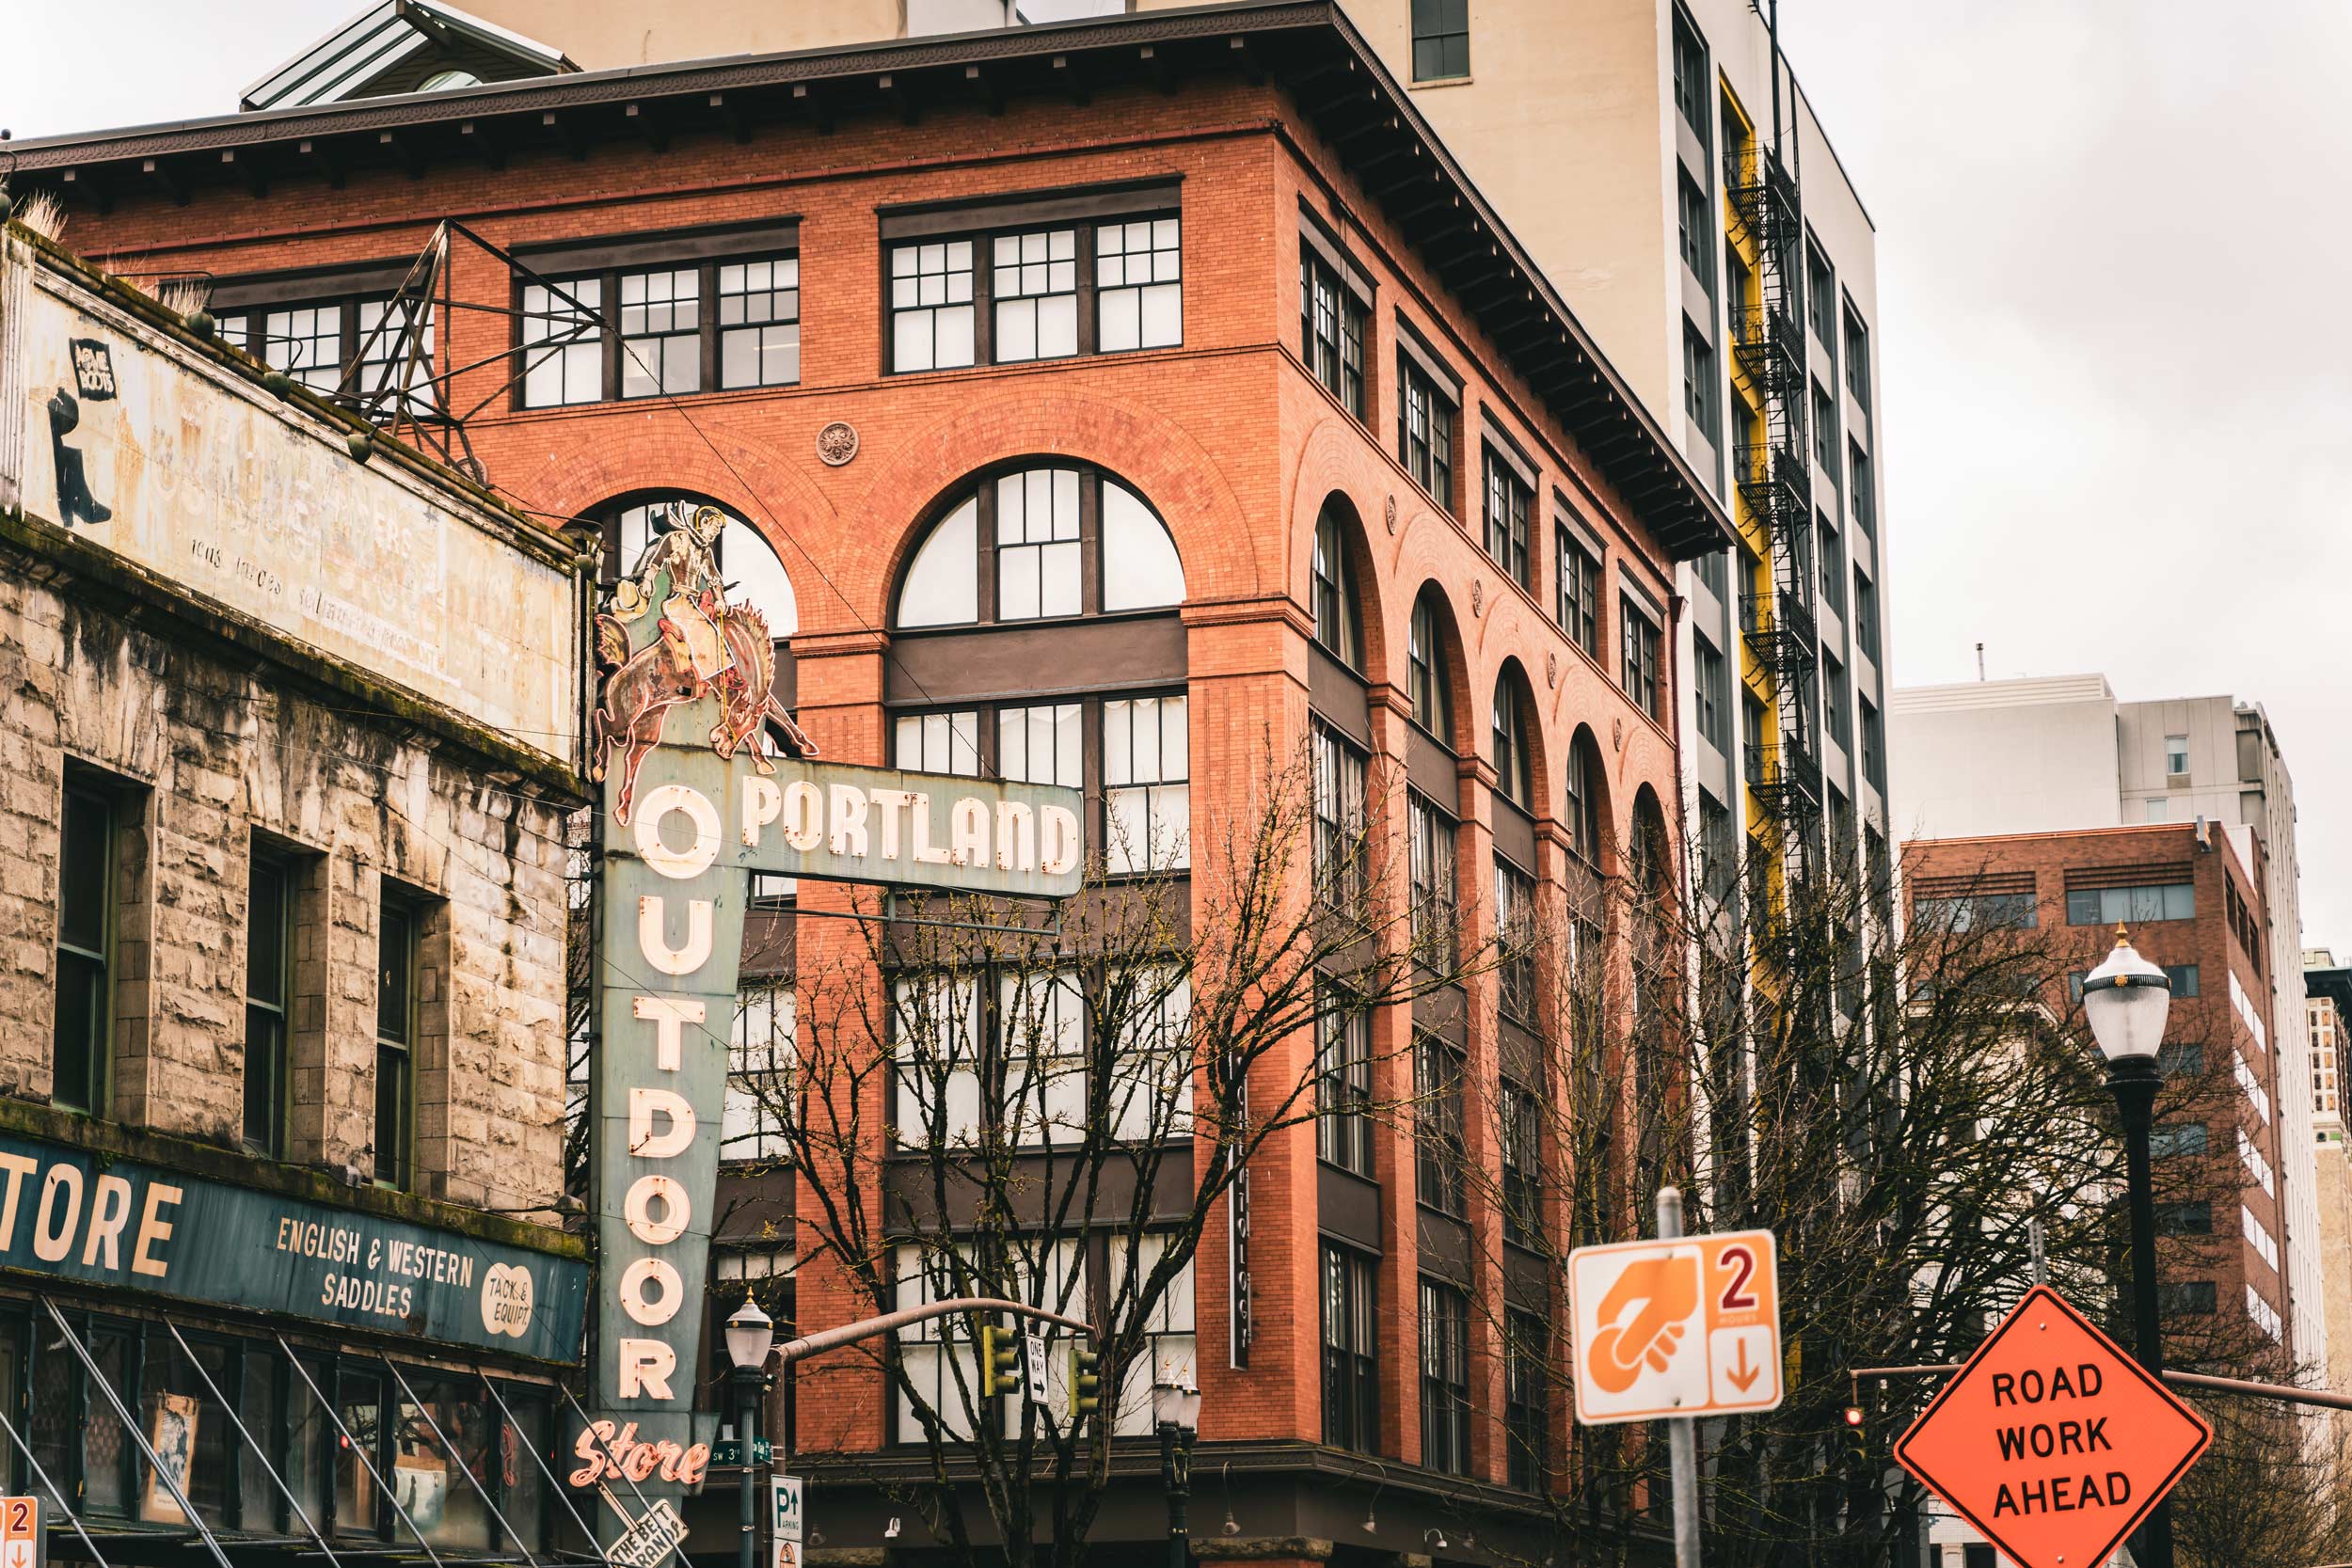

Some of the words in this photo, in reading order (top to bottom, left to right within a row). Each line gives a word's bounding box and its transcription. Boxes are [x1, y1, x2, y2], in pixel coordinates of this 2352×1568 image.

[79, 370, 114, 392] BOOTS
[742, 775, 1079, 875] PORTLAND
[618, 784, 723, 1400] OUTDOOR
[277, 1217, 360, 1264] ENGLISH
[367, 1238, 381, 1270] &
[389, 1240, 473, 1288] WESTERN
[322, 1273, 412, 1319] SADDLES
[520, 1282, 528, 1301] &
[1719, 1246, 1756, 1310] 2
[1030, 1341, 1043, 1357] ONE
[1031, 1358, 1044, 1374] WAY
[1992, 1363, 2103, 1407] ROAD
[569, 1420, 710, 1488] Store
[713, 1452, 723, 1461] SW
[1996, 1417, 2113, 1462] WORK
[12, 1502, 28, 1532] 2
[1994, 1471, 2131, 1518] AHEAD
[612, 1534, 641, 1563] THE
[637, 1506, 670, 1544] BET
